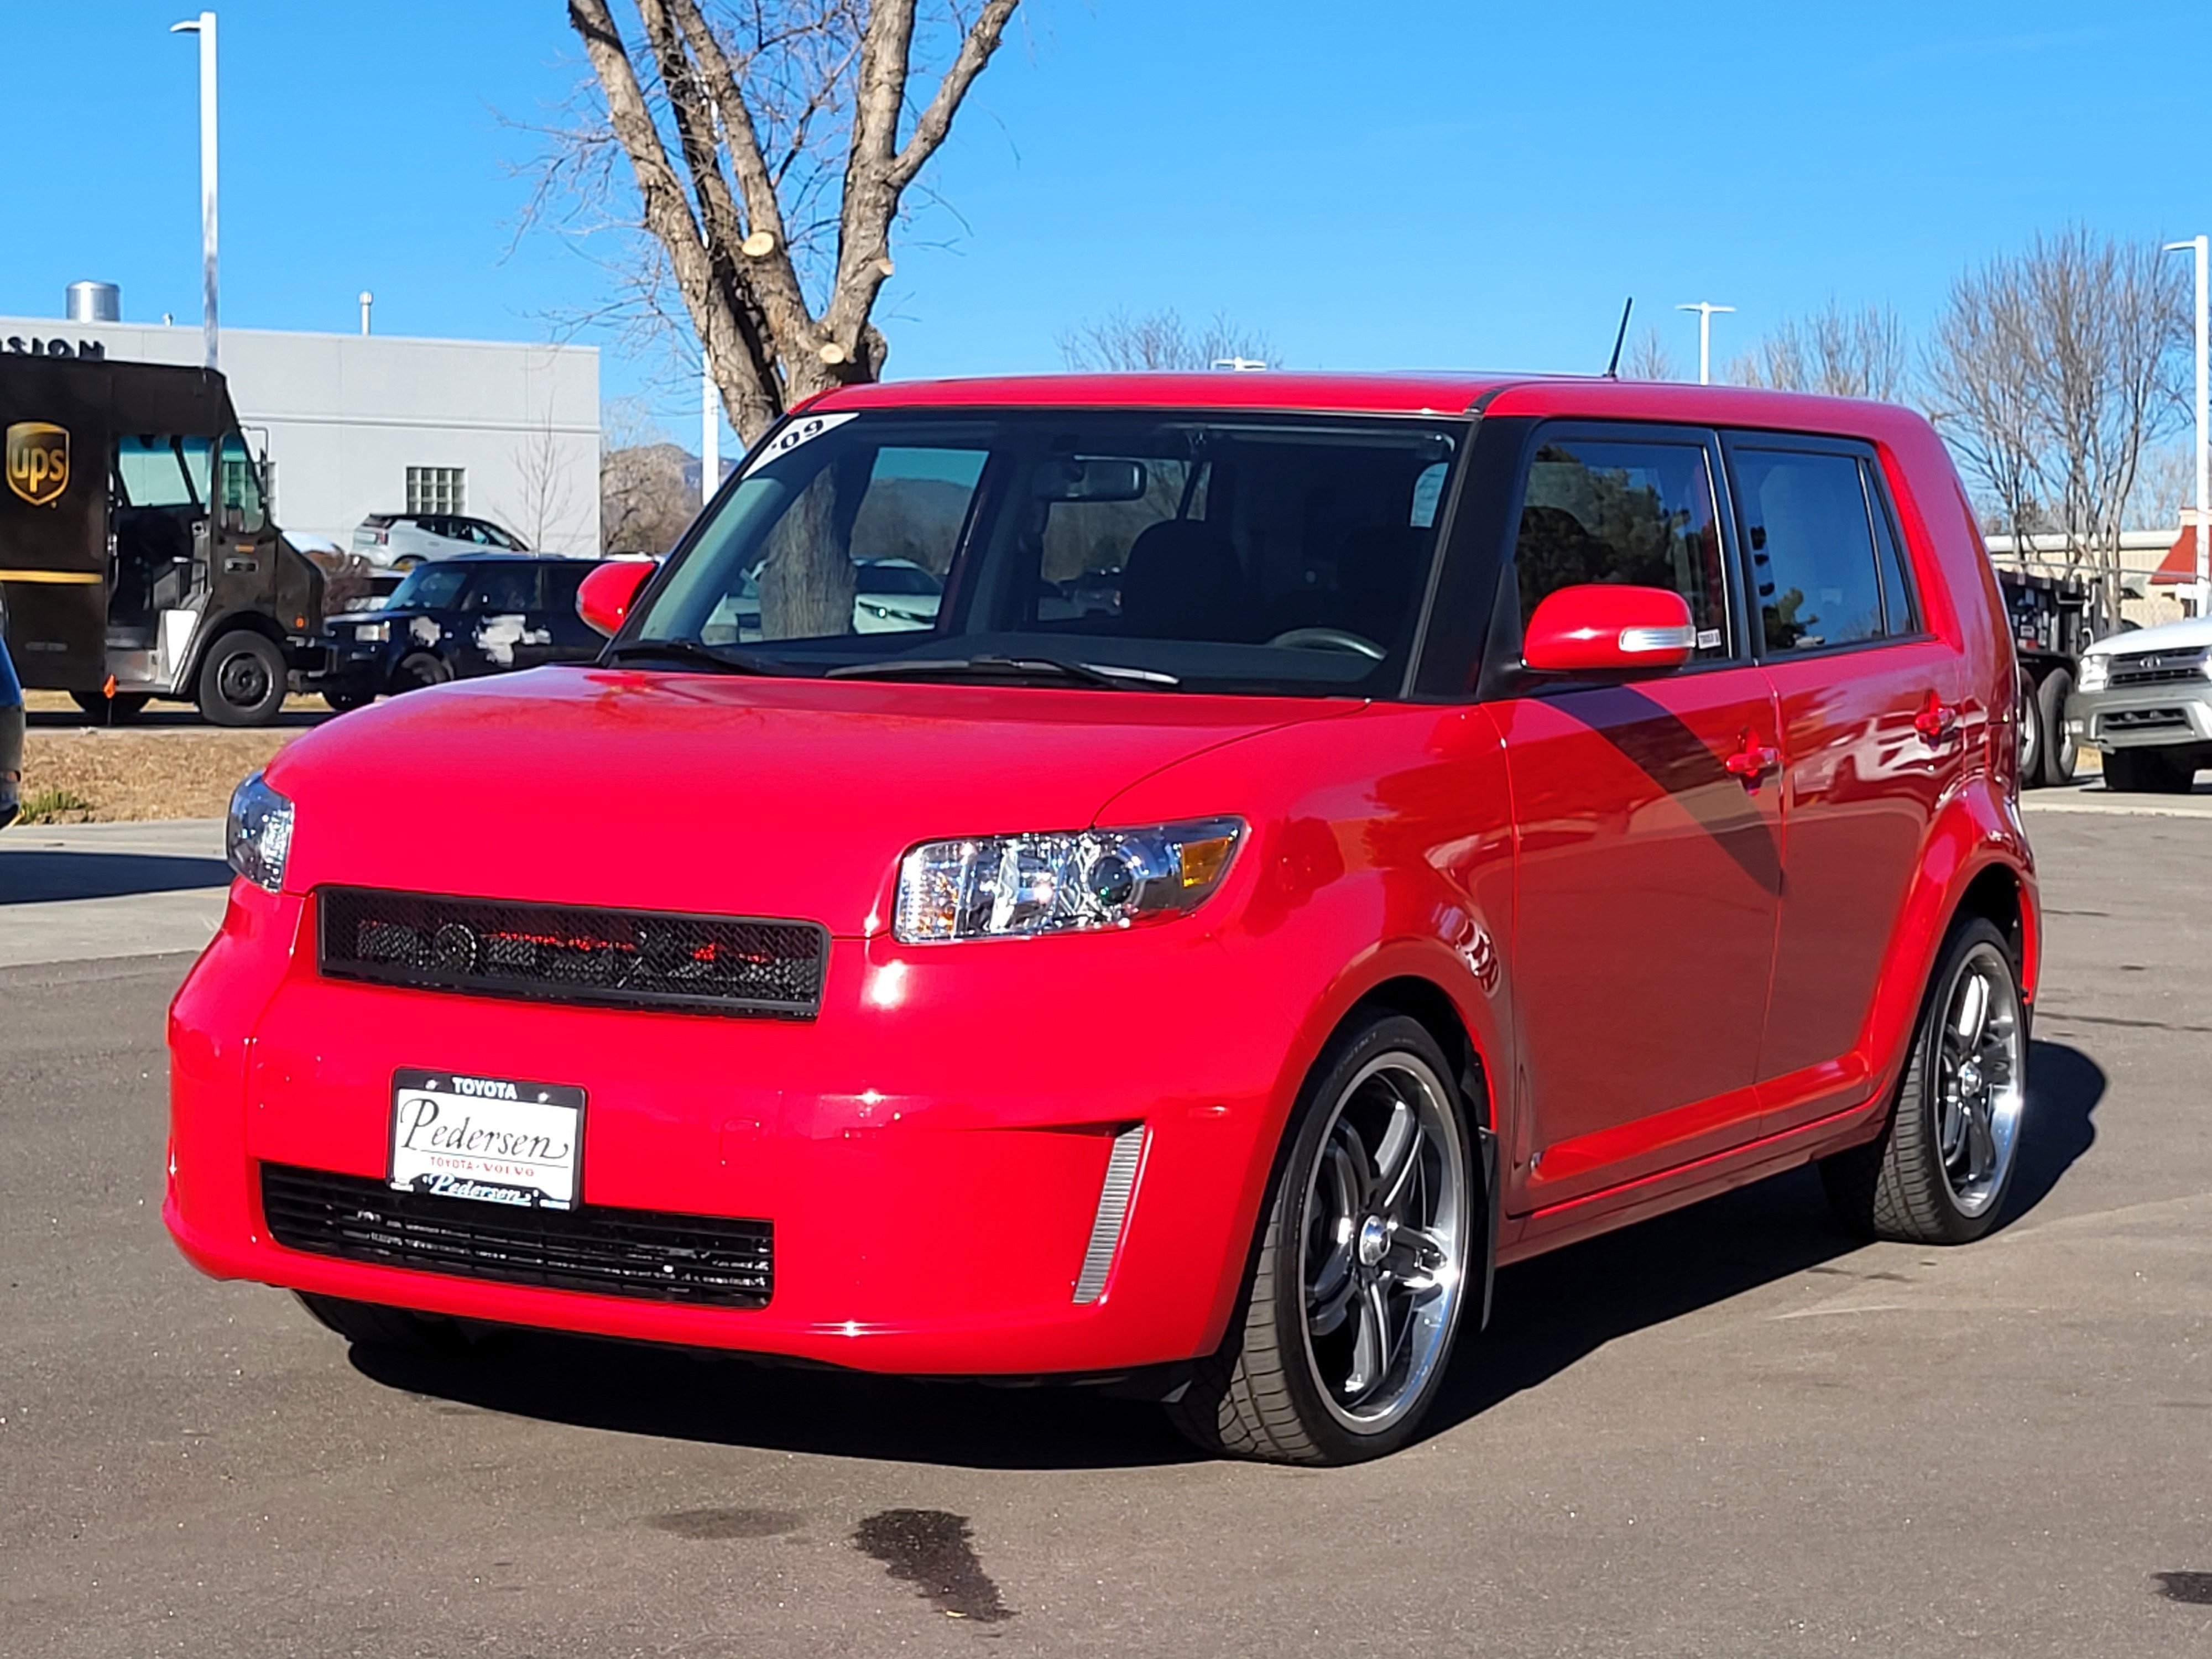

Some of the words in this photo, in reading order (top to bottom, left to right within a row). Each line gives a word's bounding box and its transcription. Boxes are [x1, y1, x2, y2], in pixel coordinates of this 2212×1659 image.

[0, 336, 105, 361] SION
[452, 1077, 518, 1099] TOYOTA
[400, 1098, 568, 1159] Pedersen
